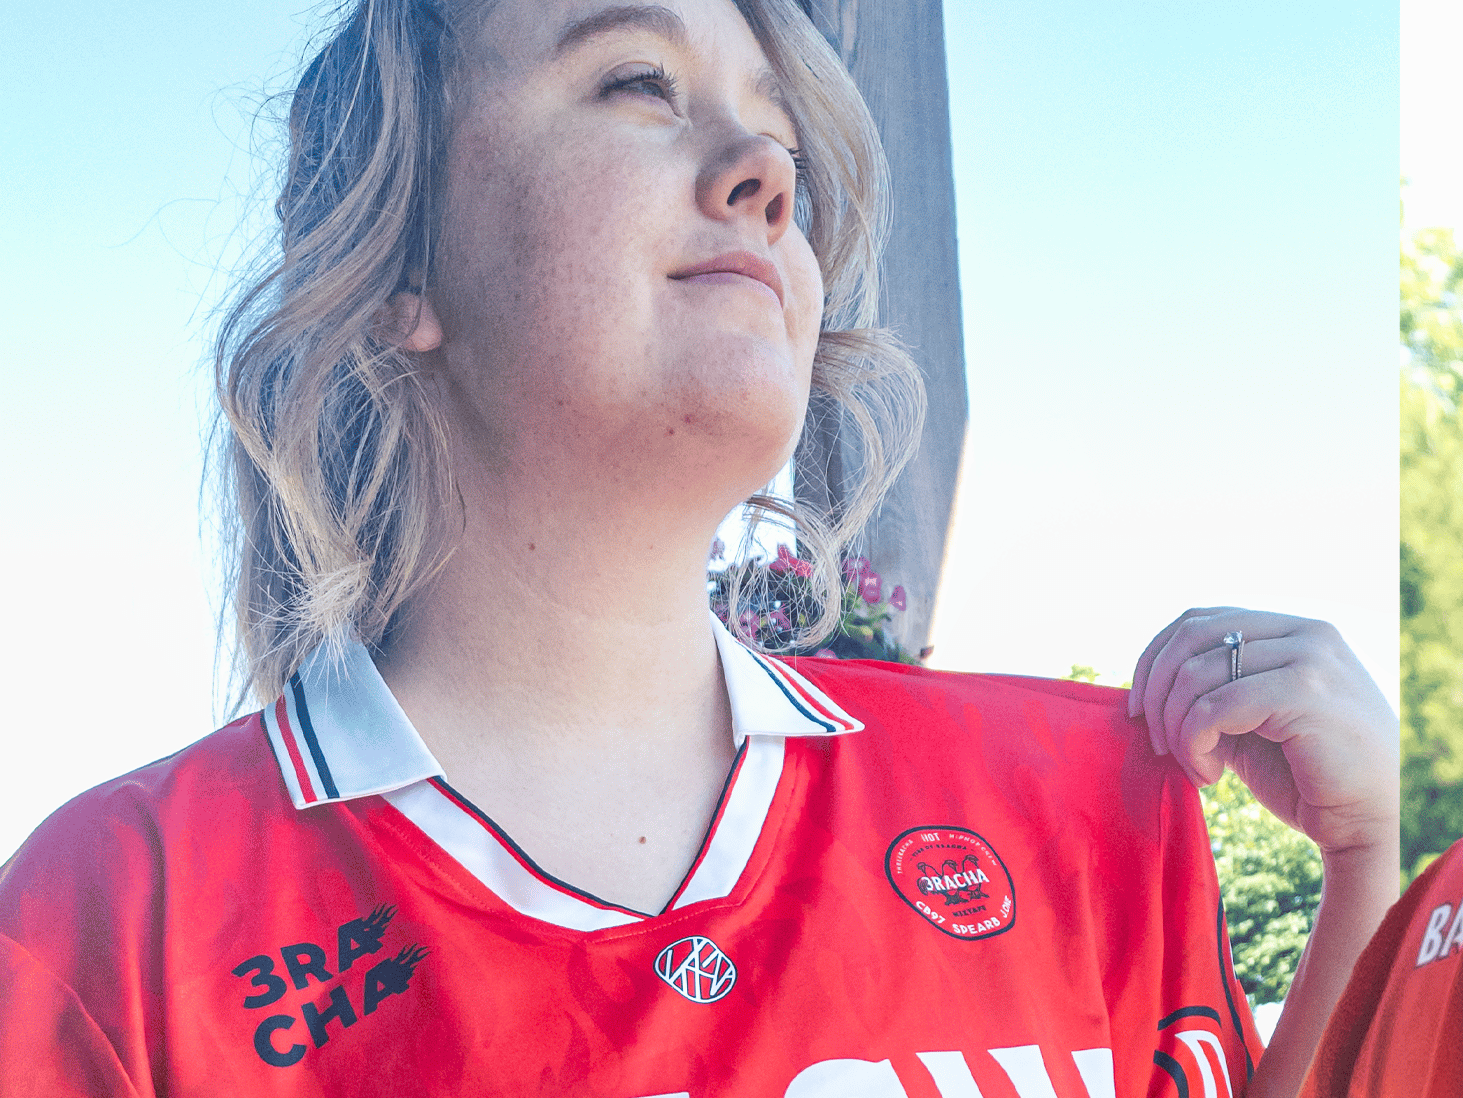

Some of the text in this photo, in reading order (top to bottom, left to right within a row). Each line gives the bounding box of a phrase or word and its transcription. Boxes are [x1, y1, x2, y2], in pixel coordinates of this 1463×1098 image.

[921, 833, 941, 842] HOT
[232, 903, 399, 1009] 3RA
[253, 943, 431, 1067] CHA
